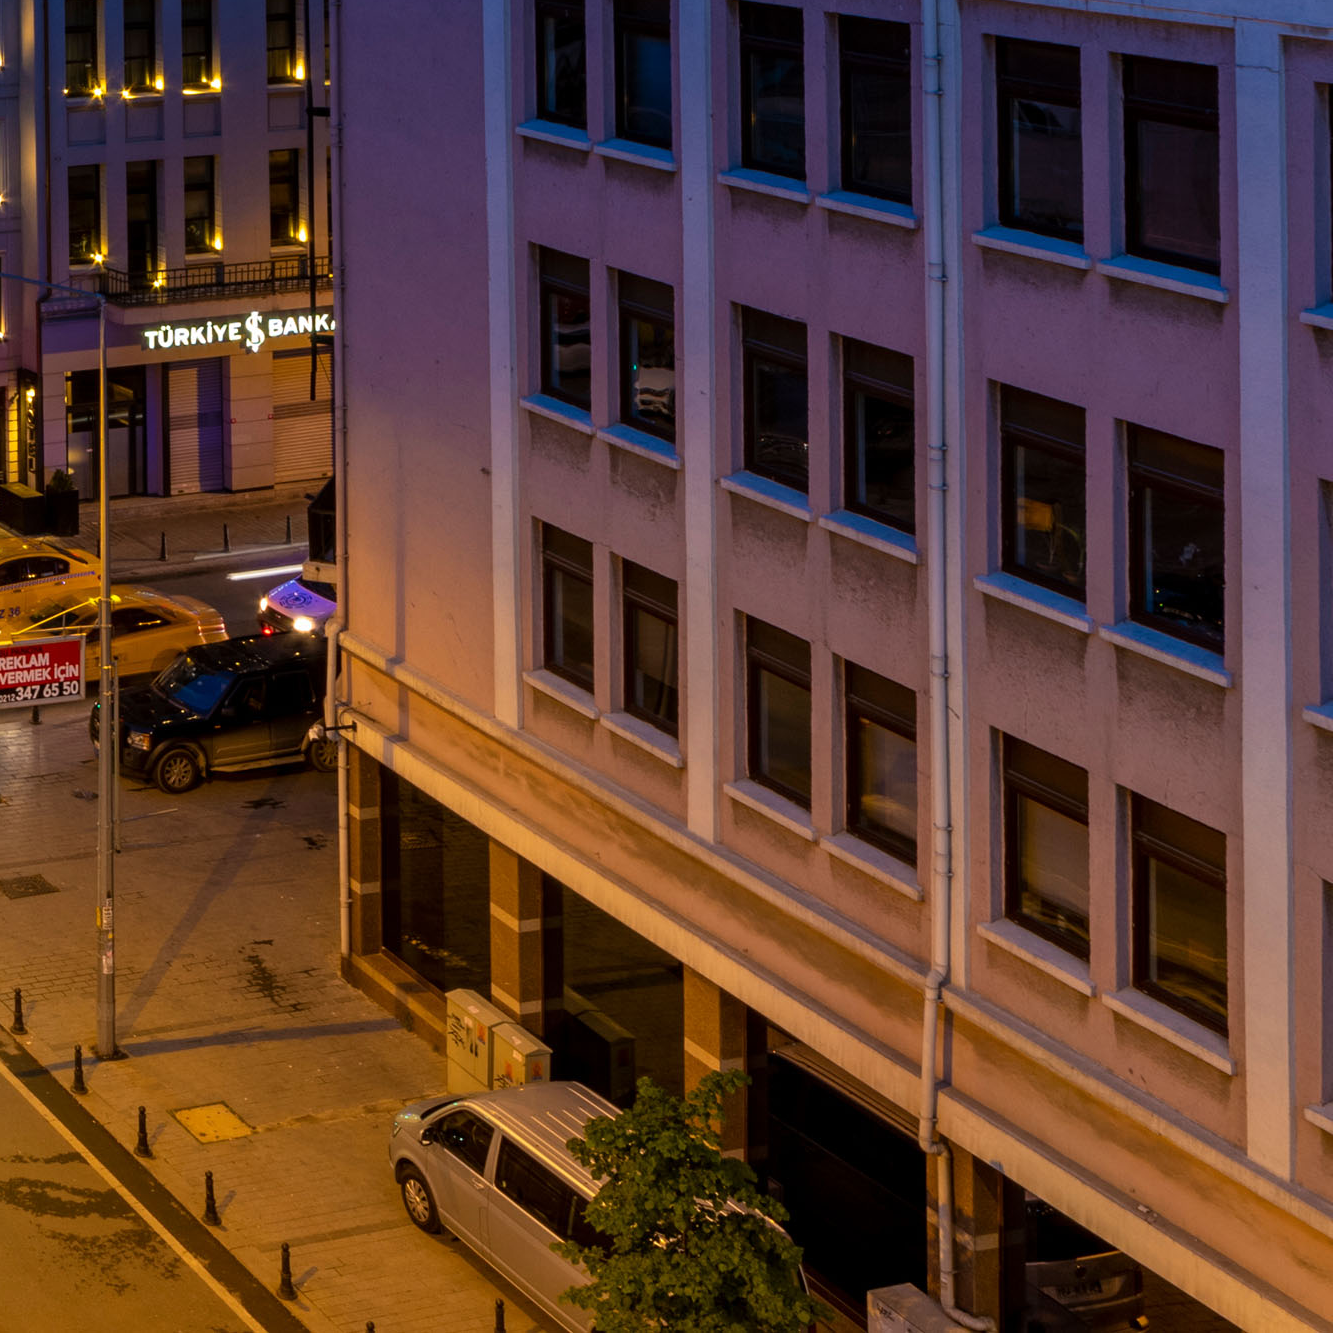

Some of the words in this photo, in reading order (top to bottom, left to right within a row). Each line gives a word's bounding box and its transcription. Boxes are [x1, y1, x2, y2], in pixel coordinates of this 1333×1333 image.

[144, 320, 242, 349] TÜRKİYE
[268, 313, 336, 338] BANK
[54, 662, 79, 682] İÇİN
[15, 685, 40, 701] 347
[43, 683, 59, 698] 65
[63, 681, 79, 695] 50
